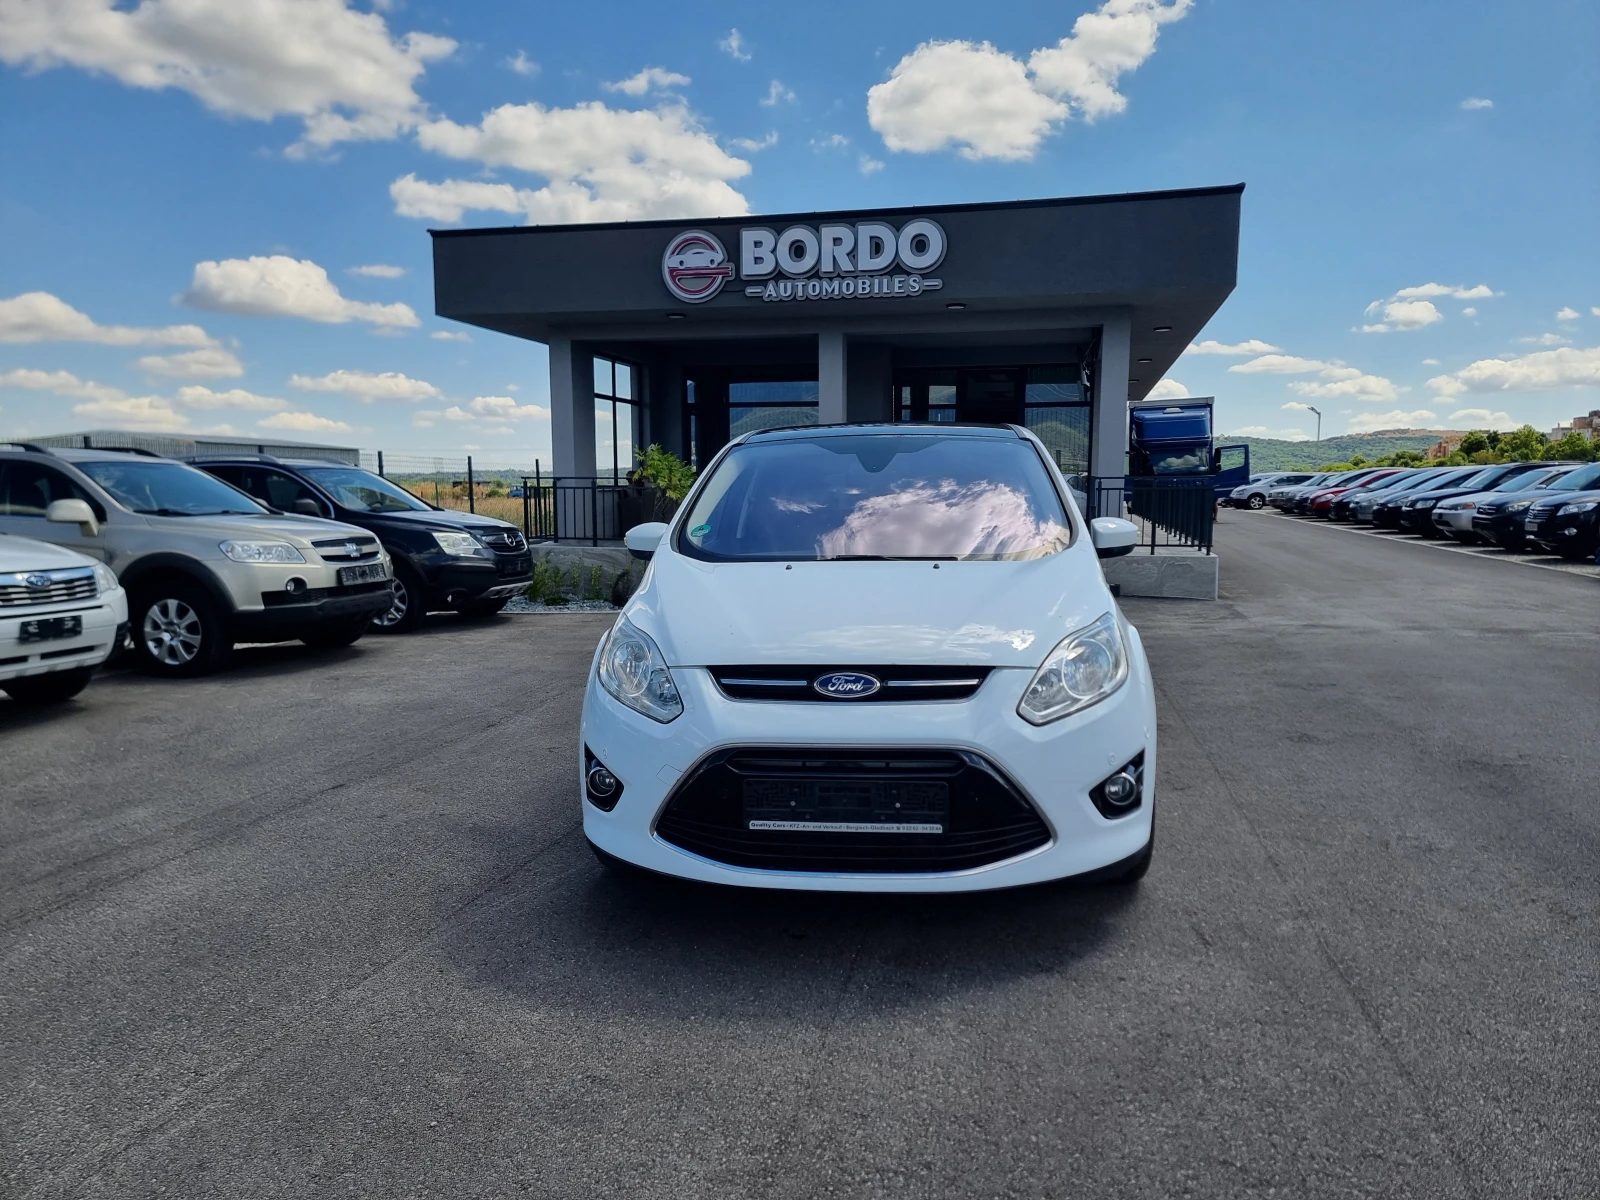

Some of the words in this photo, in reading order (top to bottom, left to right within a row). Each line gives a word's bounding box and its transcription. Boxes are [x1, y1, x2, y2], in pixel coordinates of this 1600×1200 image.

[741, 220, 945, 277] BORDO
[764, 276, 920, 298] AUTOMOBILES
[827, 675, 865, 691] Ford
